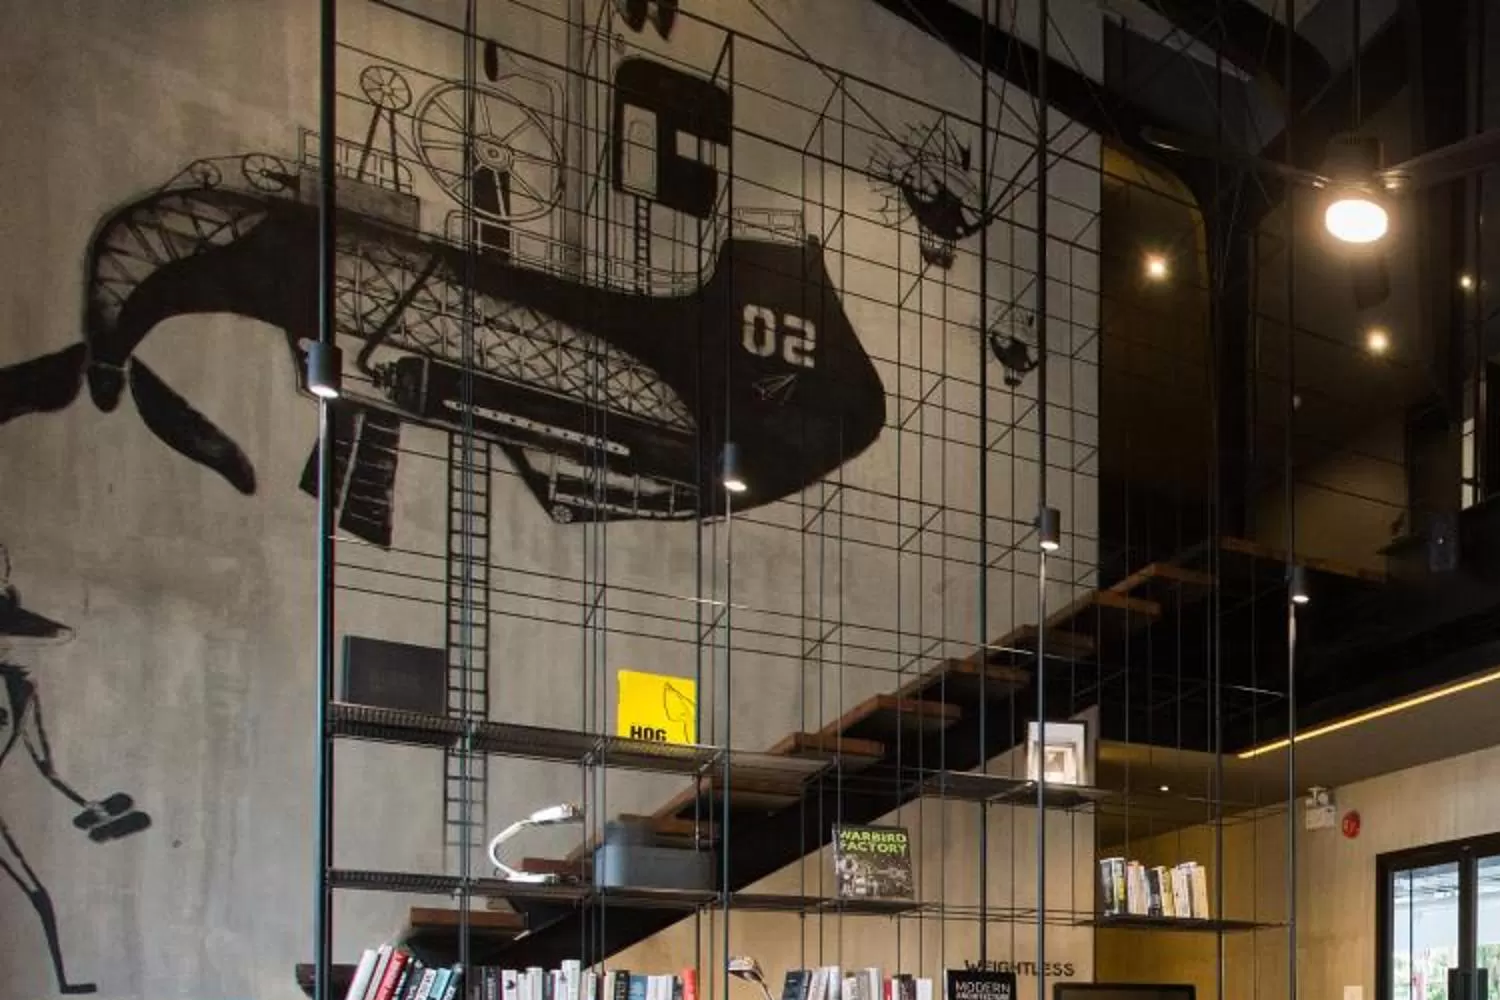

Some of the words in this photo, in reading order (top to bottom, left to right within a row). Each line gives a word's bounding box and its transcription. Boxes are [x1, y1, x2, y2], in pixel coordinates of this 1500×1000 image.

[743, 304, 816, 369] 02
[840, 841, 907, 856] FACTORY
[956, 980, 1010, 993] MODERN
